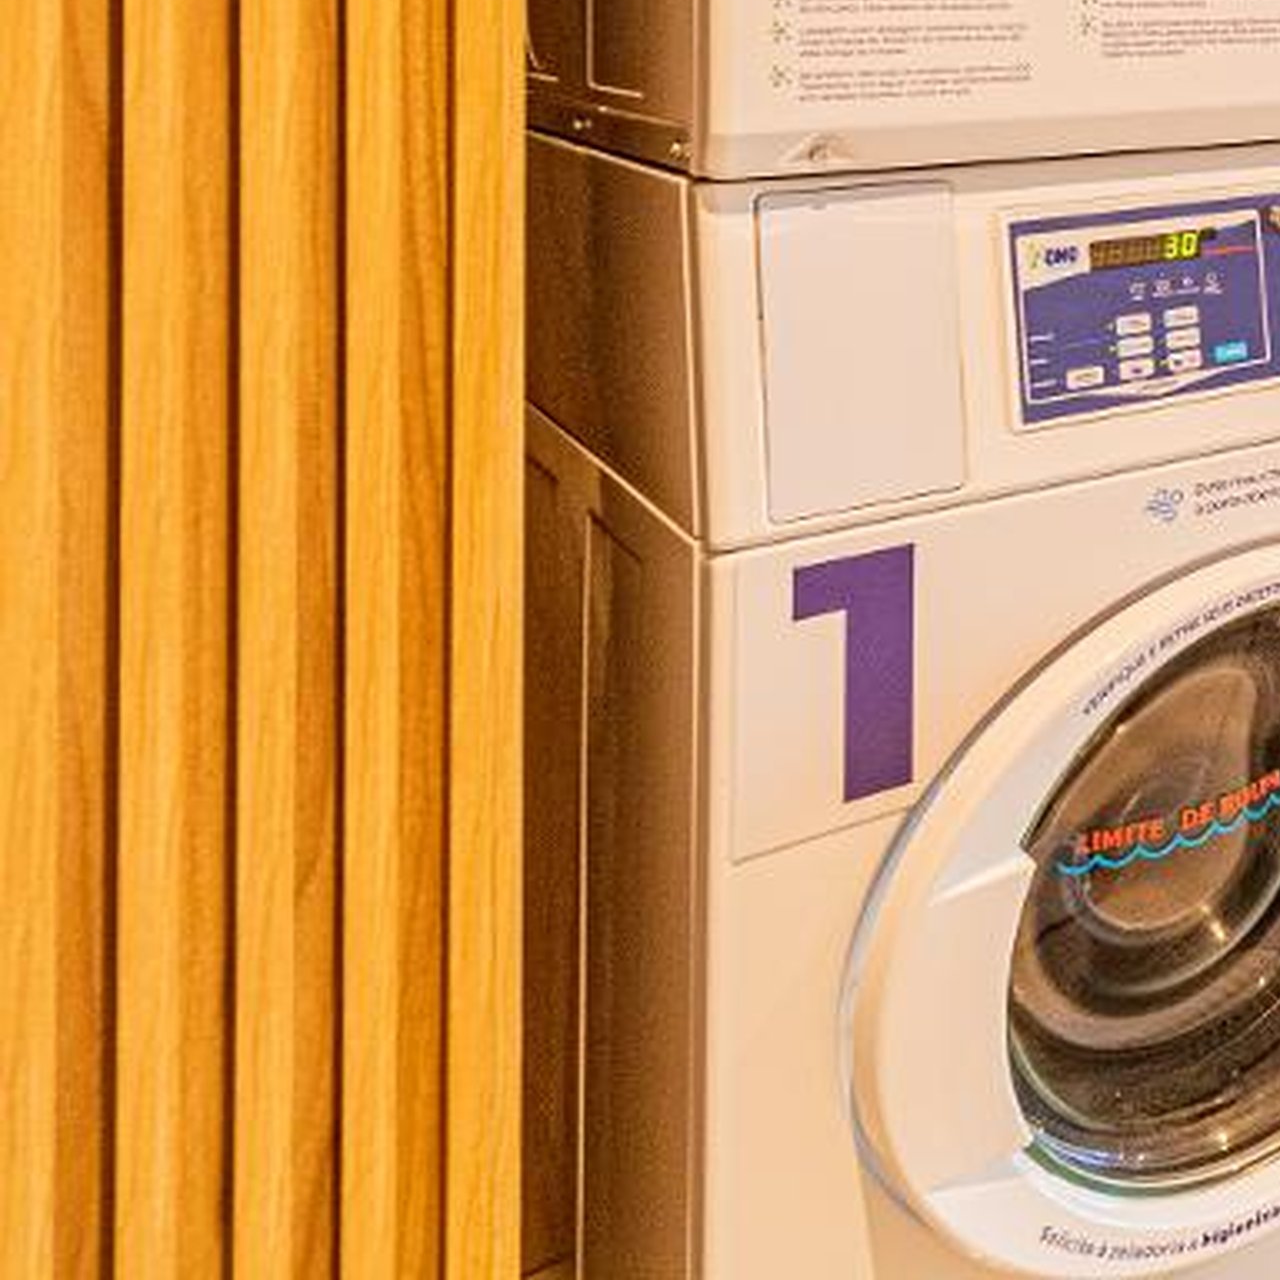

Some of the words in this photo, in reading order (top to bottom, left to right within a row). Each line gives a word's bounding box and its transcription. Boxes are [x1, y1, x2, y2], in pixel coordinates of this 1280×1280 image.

[1044, 244, 1080, 268] OMO
[1163, 231, 1199, 258] 30
[792, 542, 915, 804] 1
[1076, 818, 1165, 856] LIMITE
[1181, 801, 1216, 831] DE
